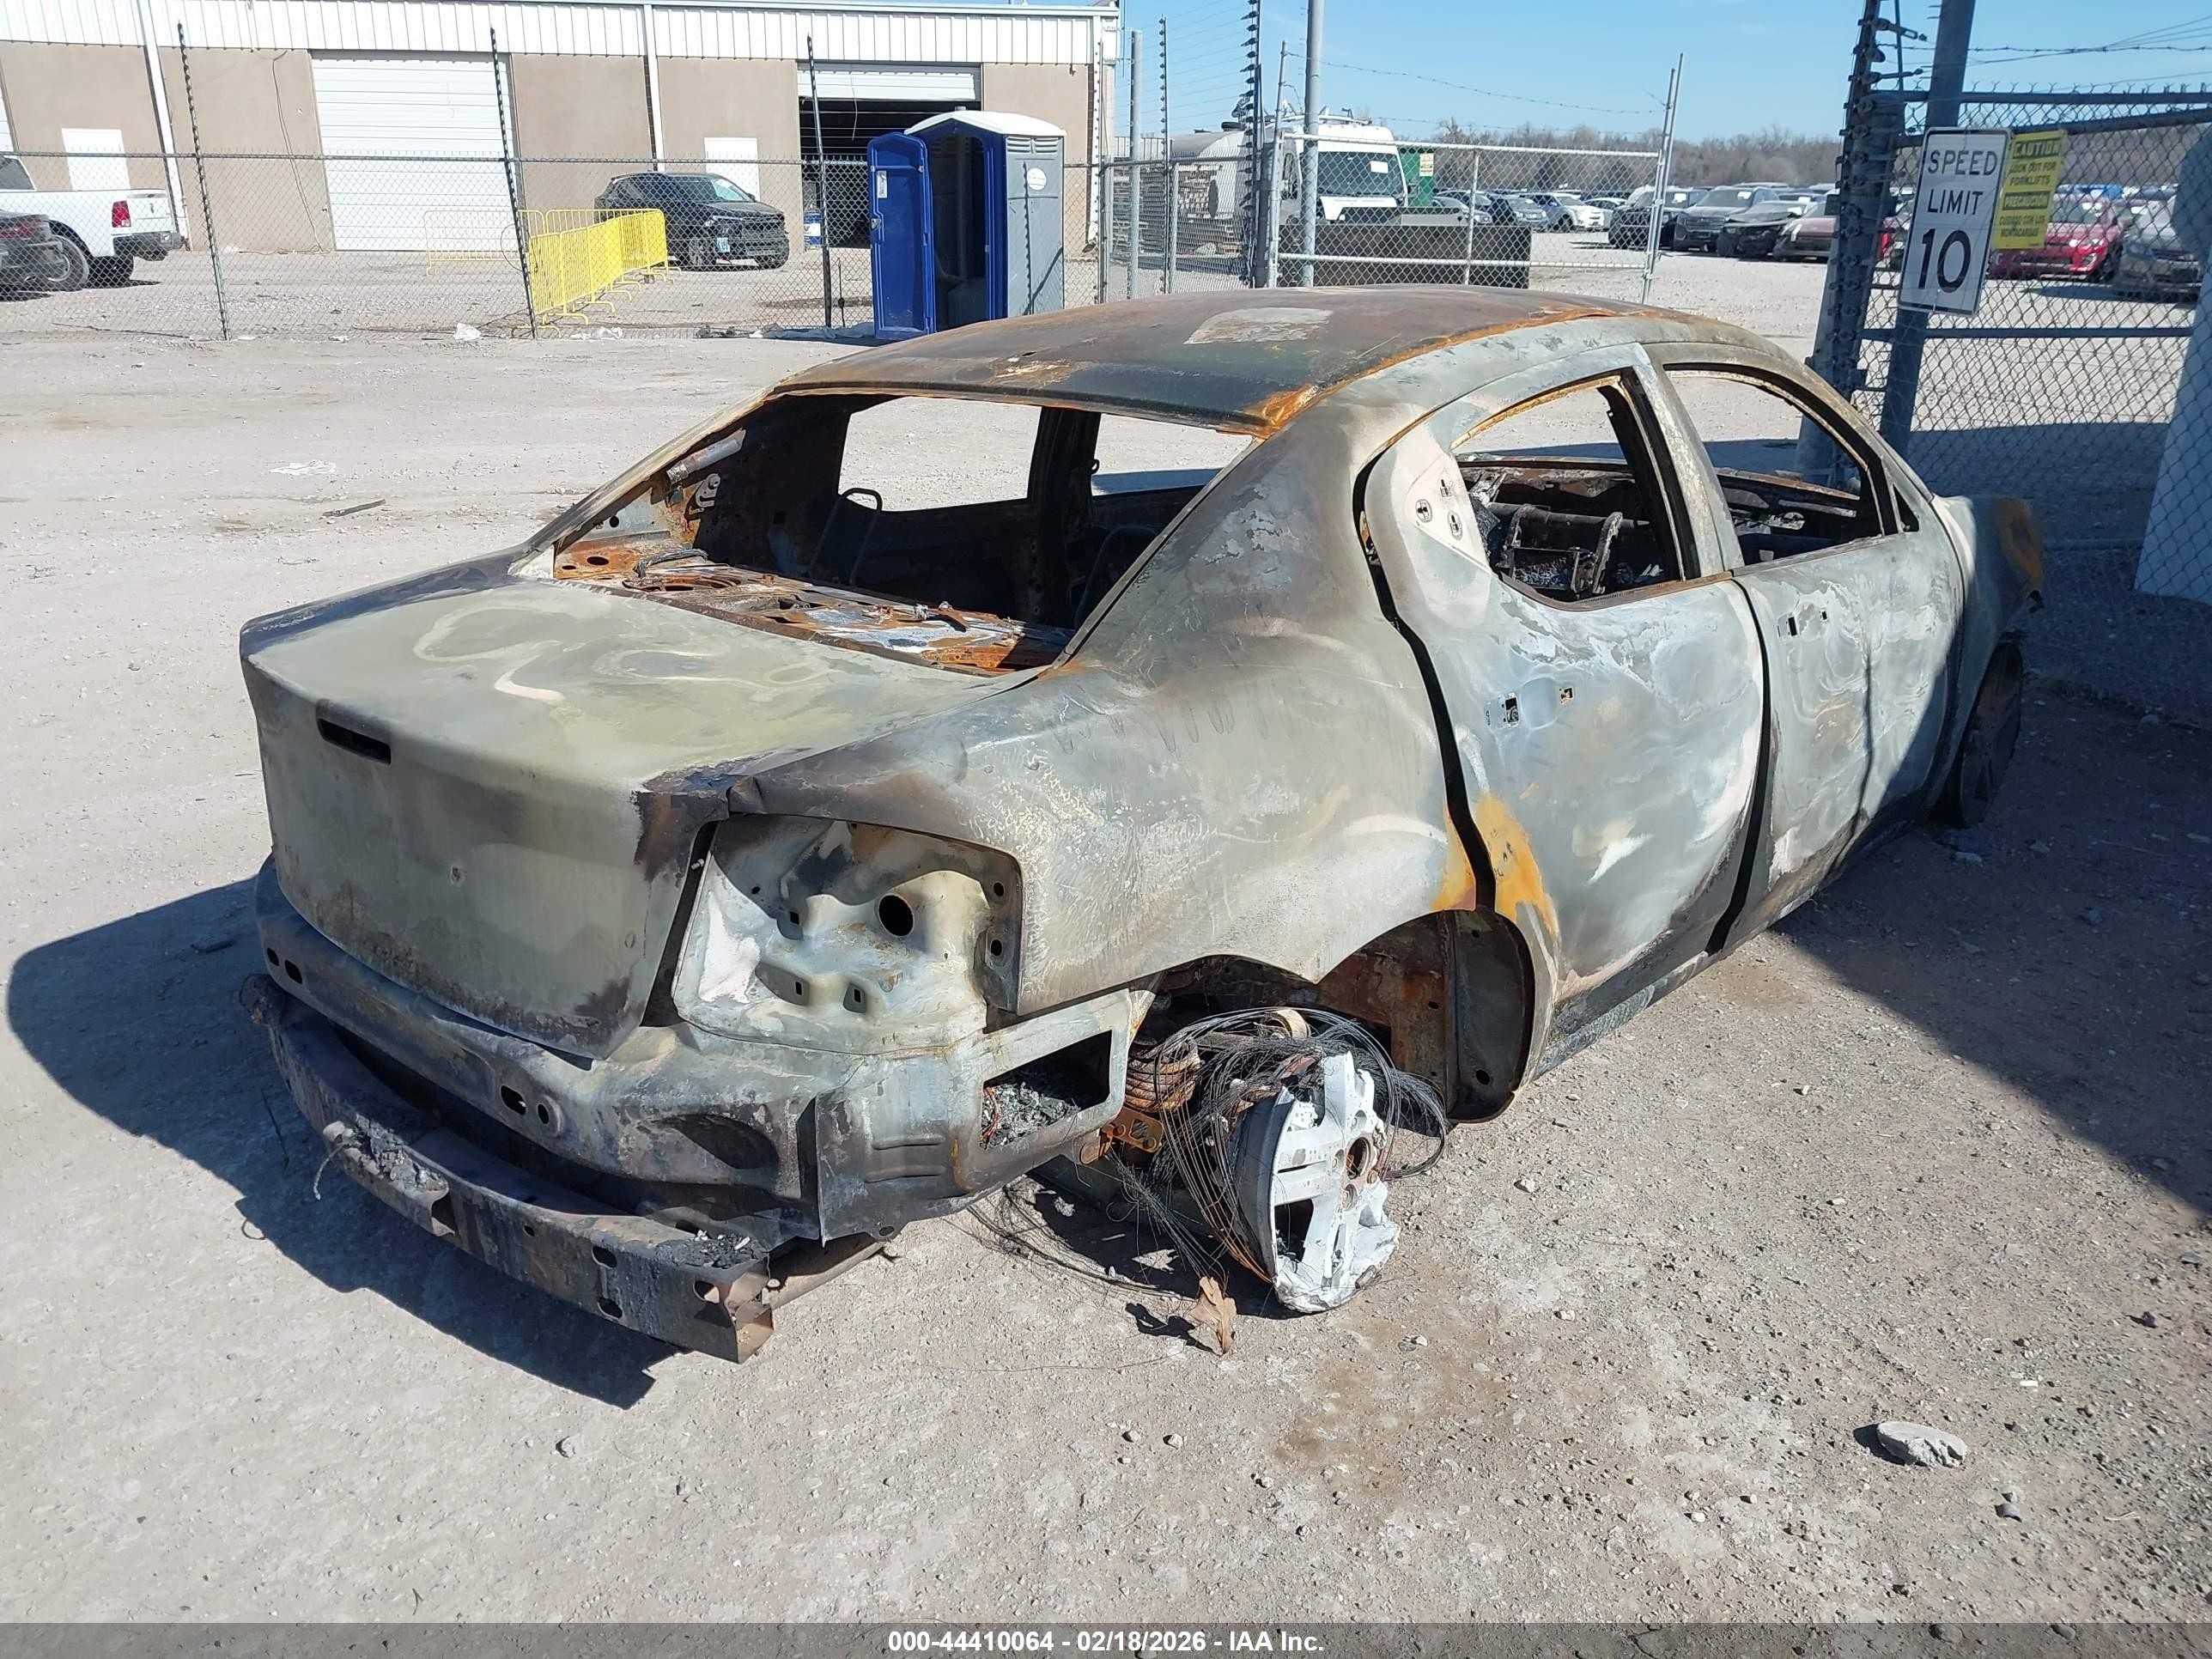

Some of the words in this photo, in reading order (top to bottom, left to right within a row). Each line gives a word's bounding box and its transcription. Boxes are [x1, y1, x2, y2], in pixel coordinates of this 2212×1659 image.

[2013, 140, 2061, 159] CAUTION
[1928, 149, 1998, 176] SPEED
[2009, 163, 2028, 175] LOOK
[2027, 161, 2043, 173] OUT
[2044, 161, 2057, 172] FOR
[2009, 174, 2051, 186] FORKLIFTS
[1927, 189, 1984, 216] LIMIT
[1917, 228, 1972, 294] 10
